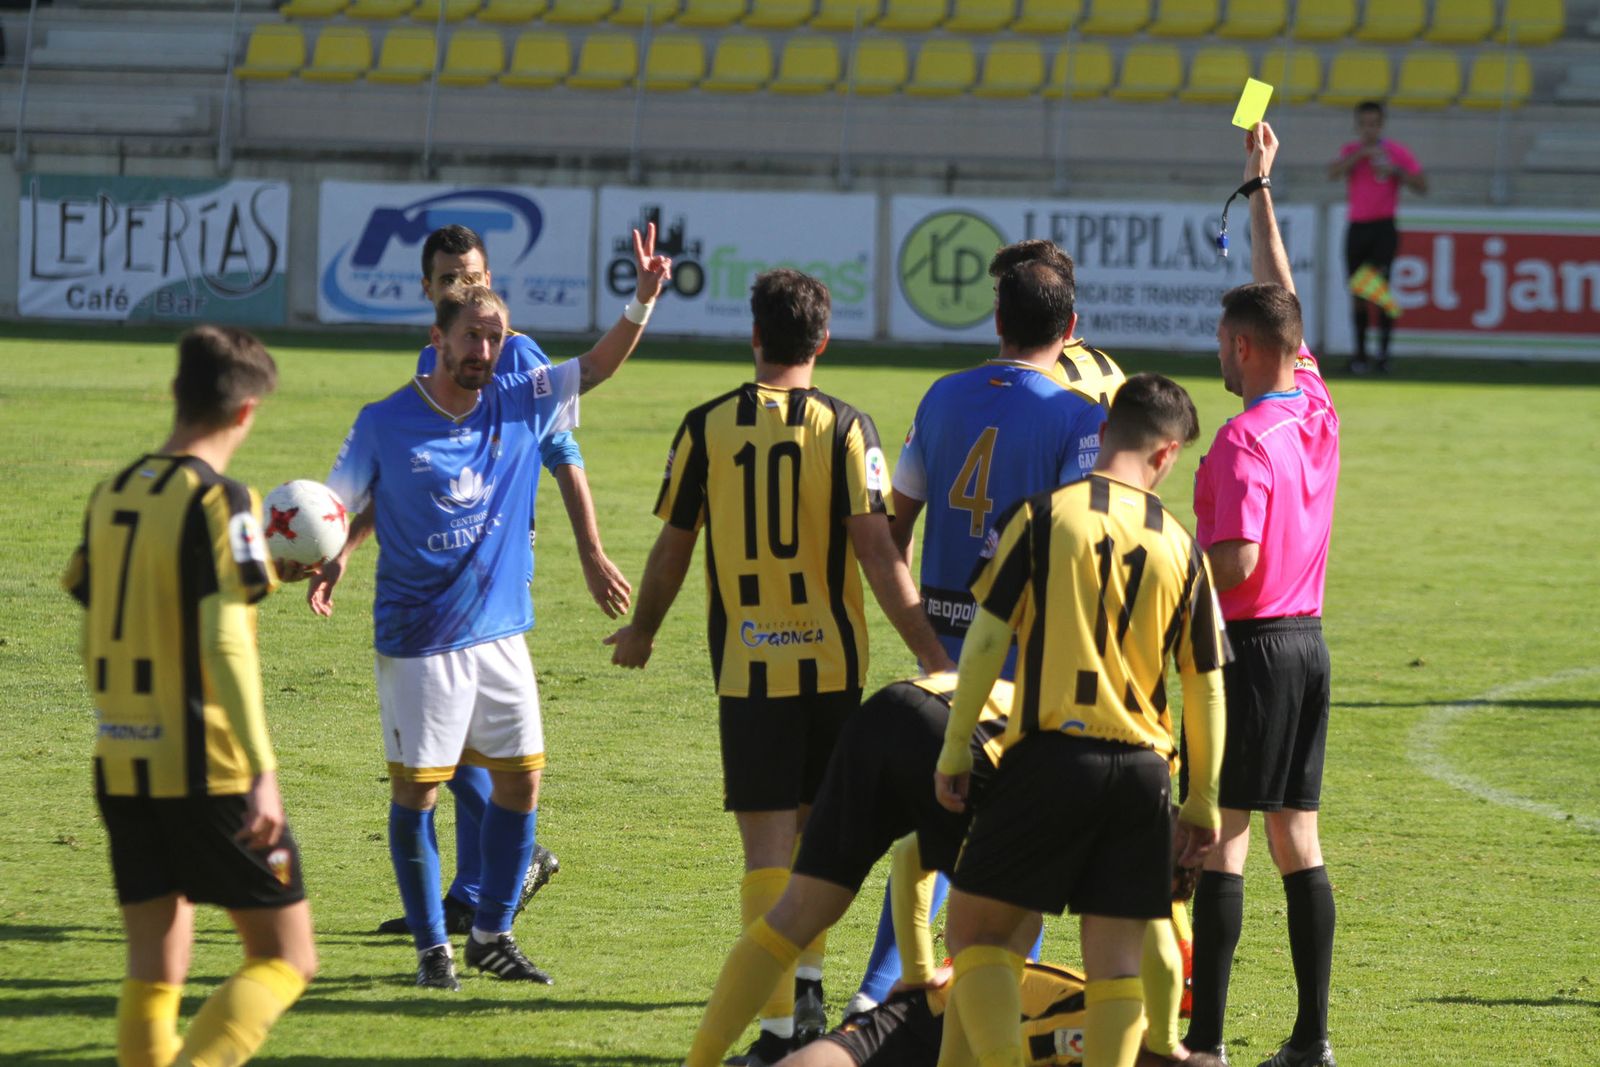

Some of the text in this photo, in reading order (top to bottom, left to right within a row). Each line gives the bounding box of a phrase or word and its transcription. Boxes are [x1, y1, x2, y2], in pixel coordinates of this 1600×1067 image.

[65, 285, 129, 312] Café
[1390, 235, 1460, 311] el
[733, 440, 802, 560] 10
[948, 426, 999, 538] 4
[112, 511, 139, 641] 7
[1095, 533, 1147, 657] 11
[767, 629, 825, 647] GONCA
